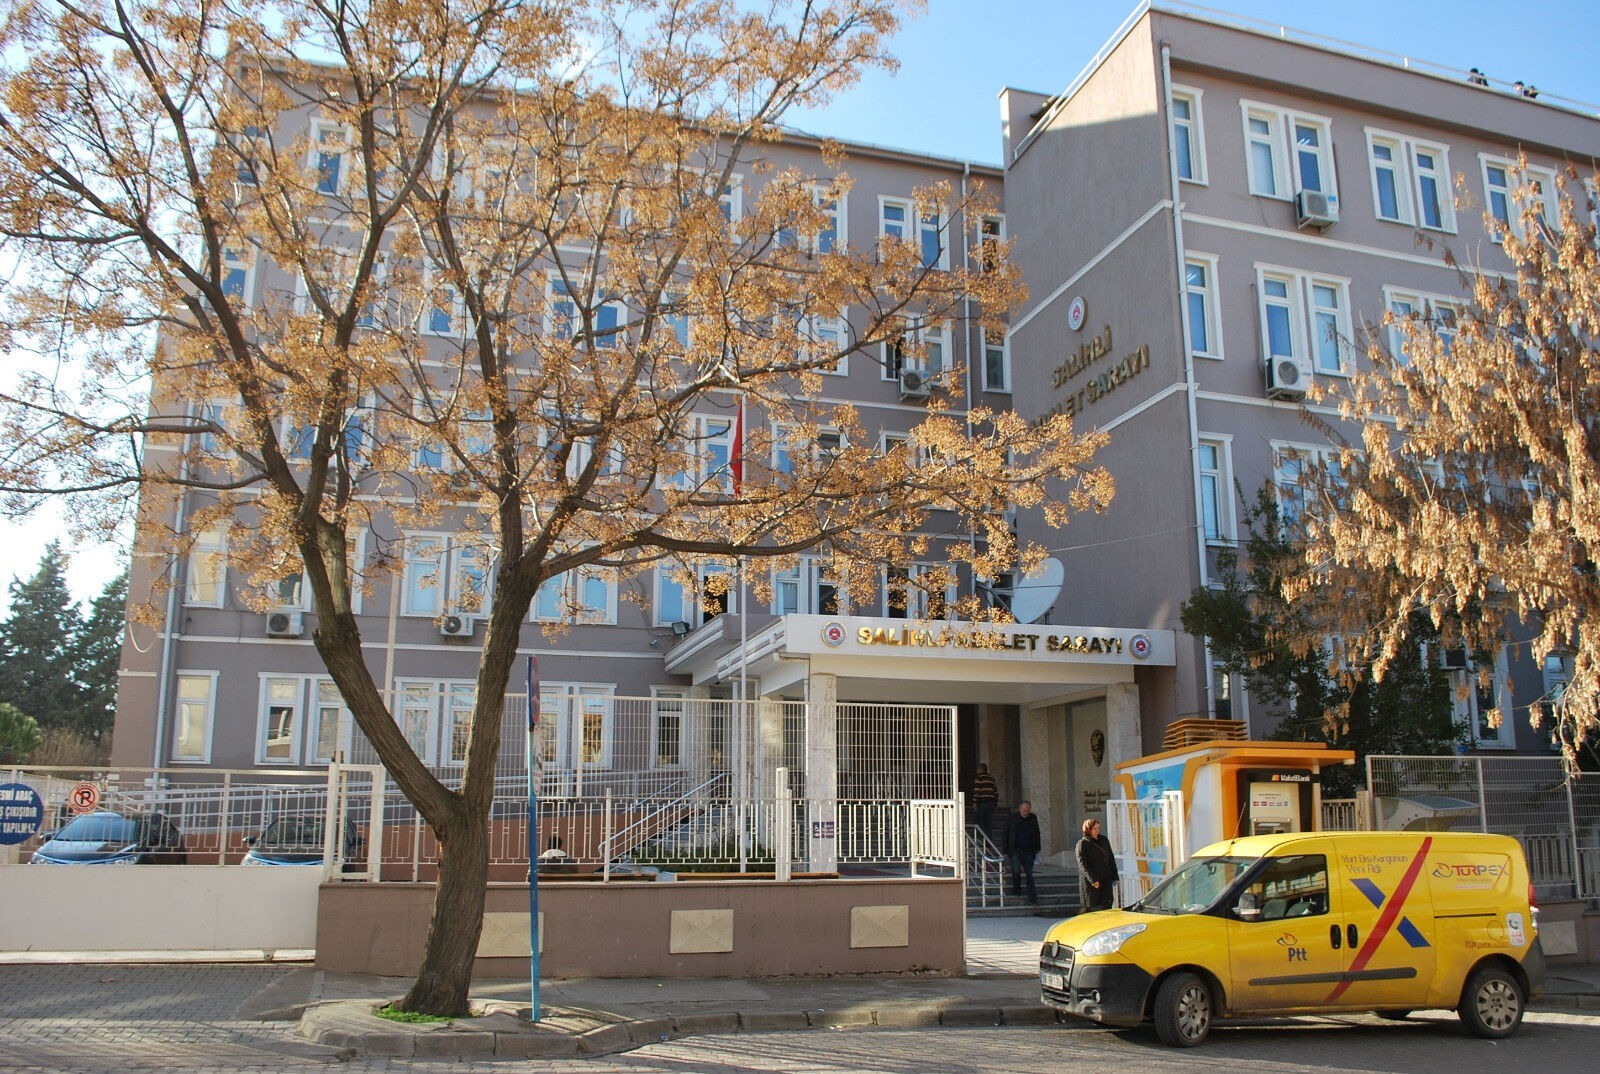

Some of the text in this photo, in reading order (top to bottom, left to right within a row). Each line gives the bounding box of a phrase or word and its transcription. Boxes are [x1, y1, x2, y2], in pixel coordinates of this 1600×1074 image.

[1050, 323, 1112, 389] SALİHLİ
[1085, 344, 1149, 403] SARAYI
[1046, 634, 1122, 654] SARAYI
[1288, 947, 1307, 962] Ptt
